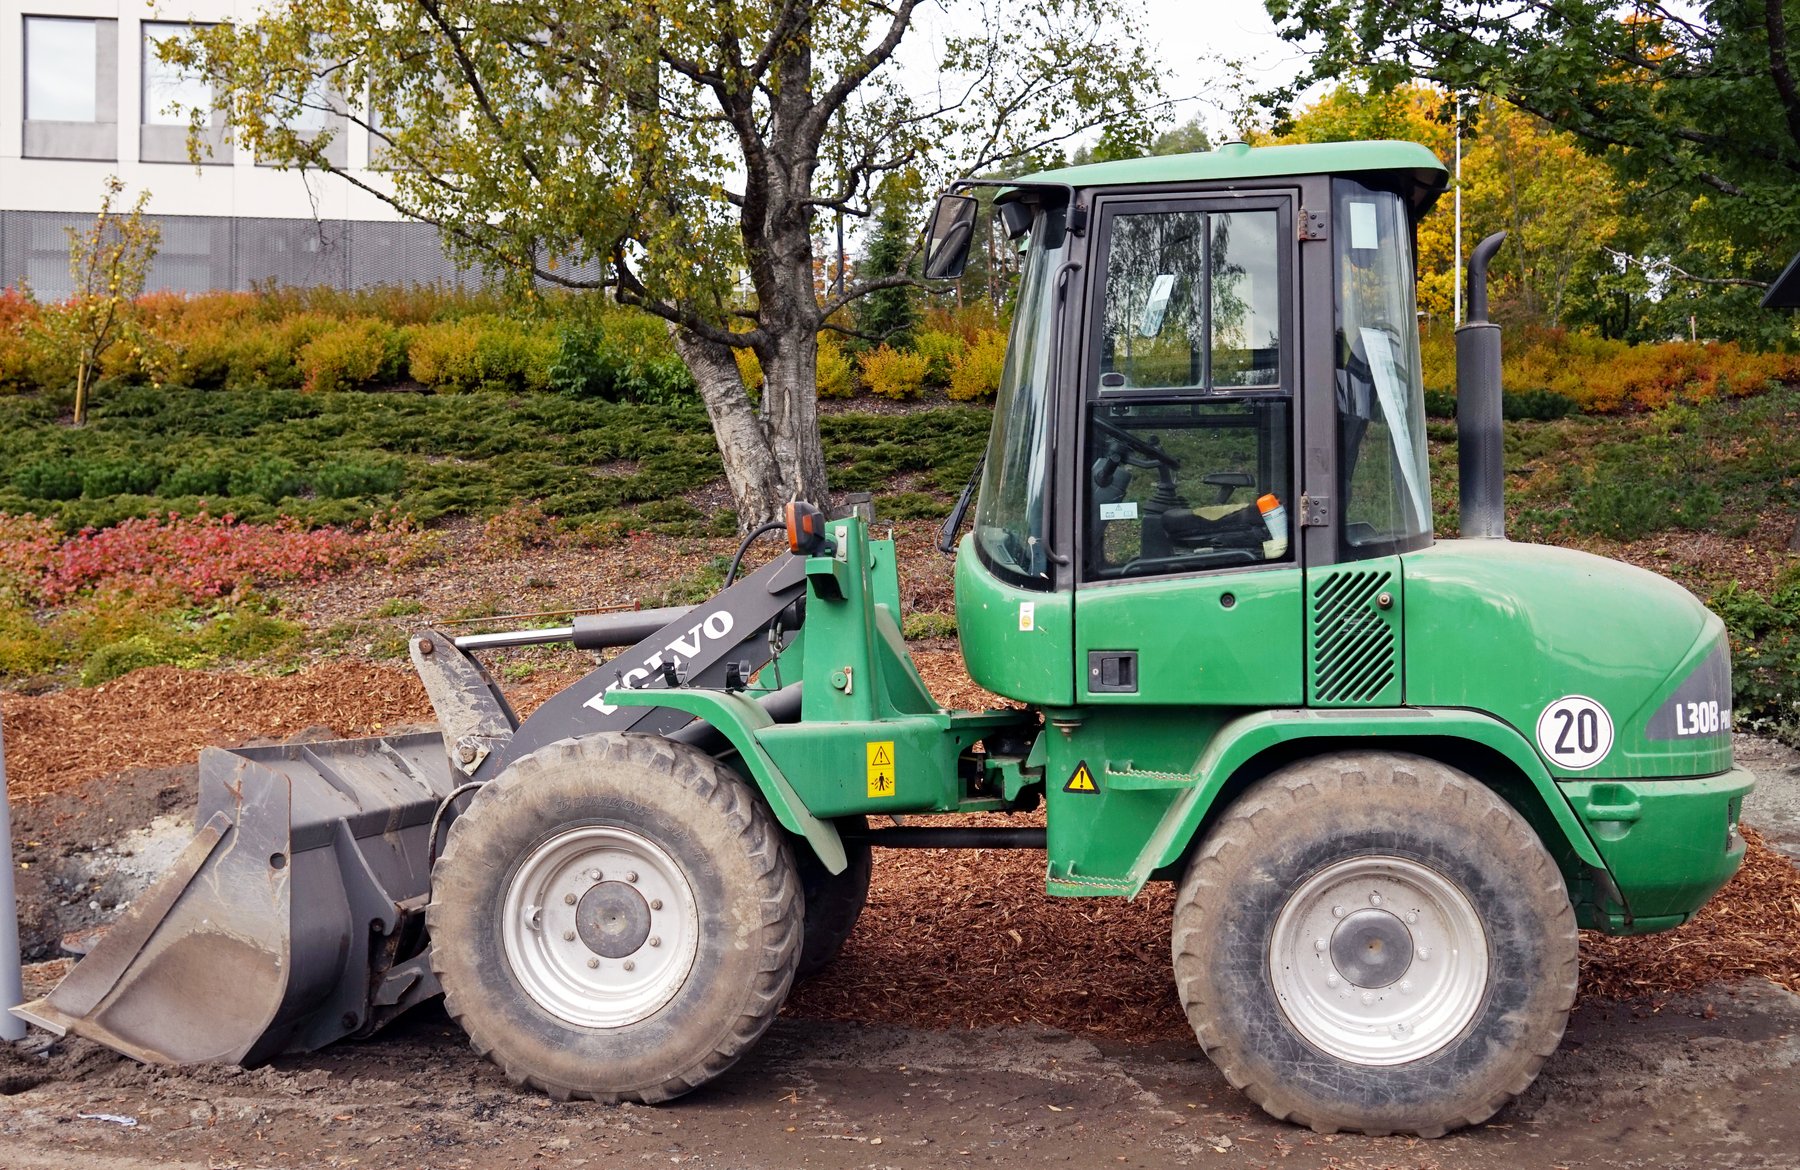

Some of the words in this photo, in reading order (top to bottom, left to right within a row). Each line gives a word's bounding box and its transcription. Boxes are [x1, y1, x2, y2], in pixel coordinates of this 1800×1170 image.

[1553, 708, 1599, 754] 20
[1676, 700, 1719, 735] L30B
[555, 795, 655, 816] DUNLOP
